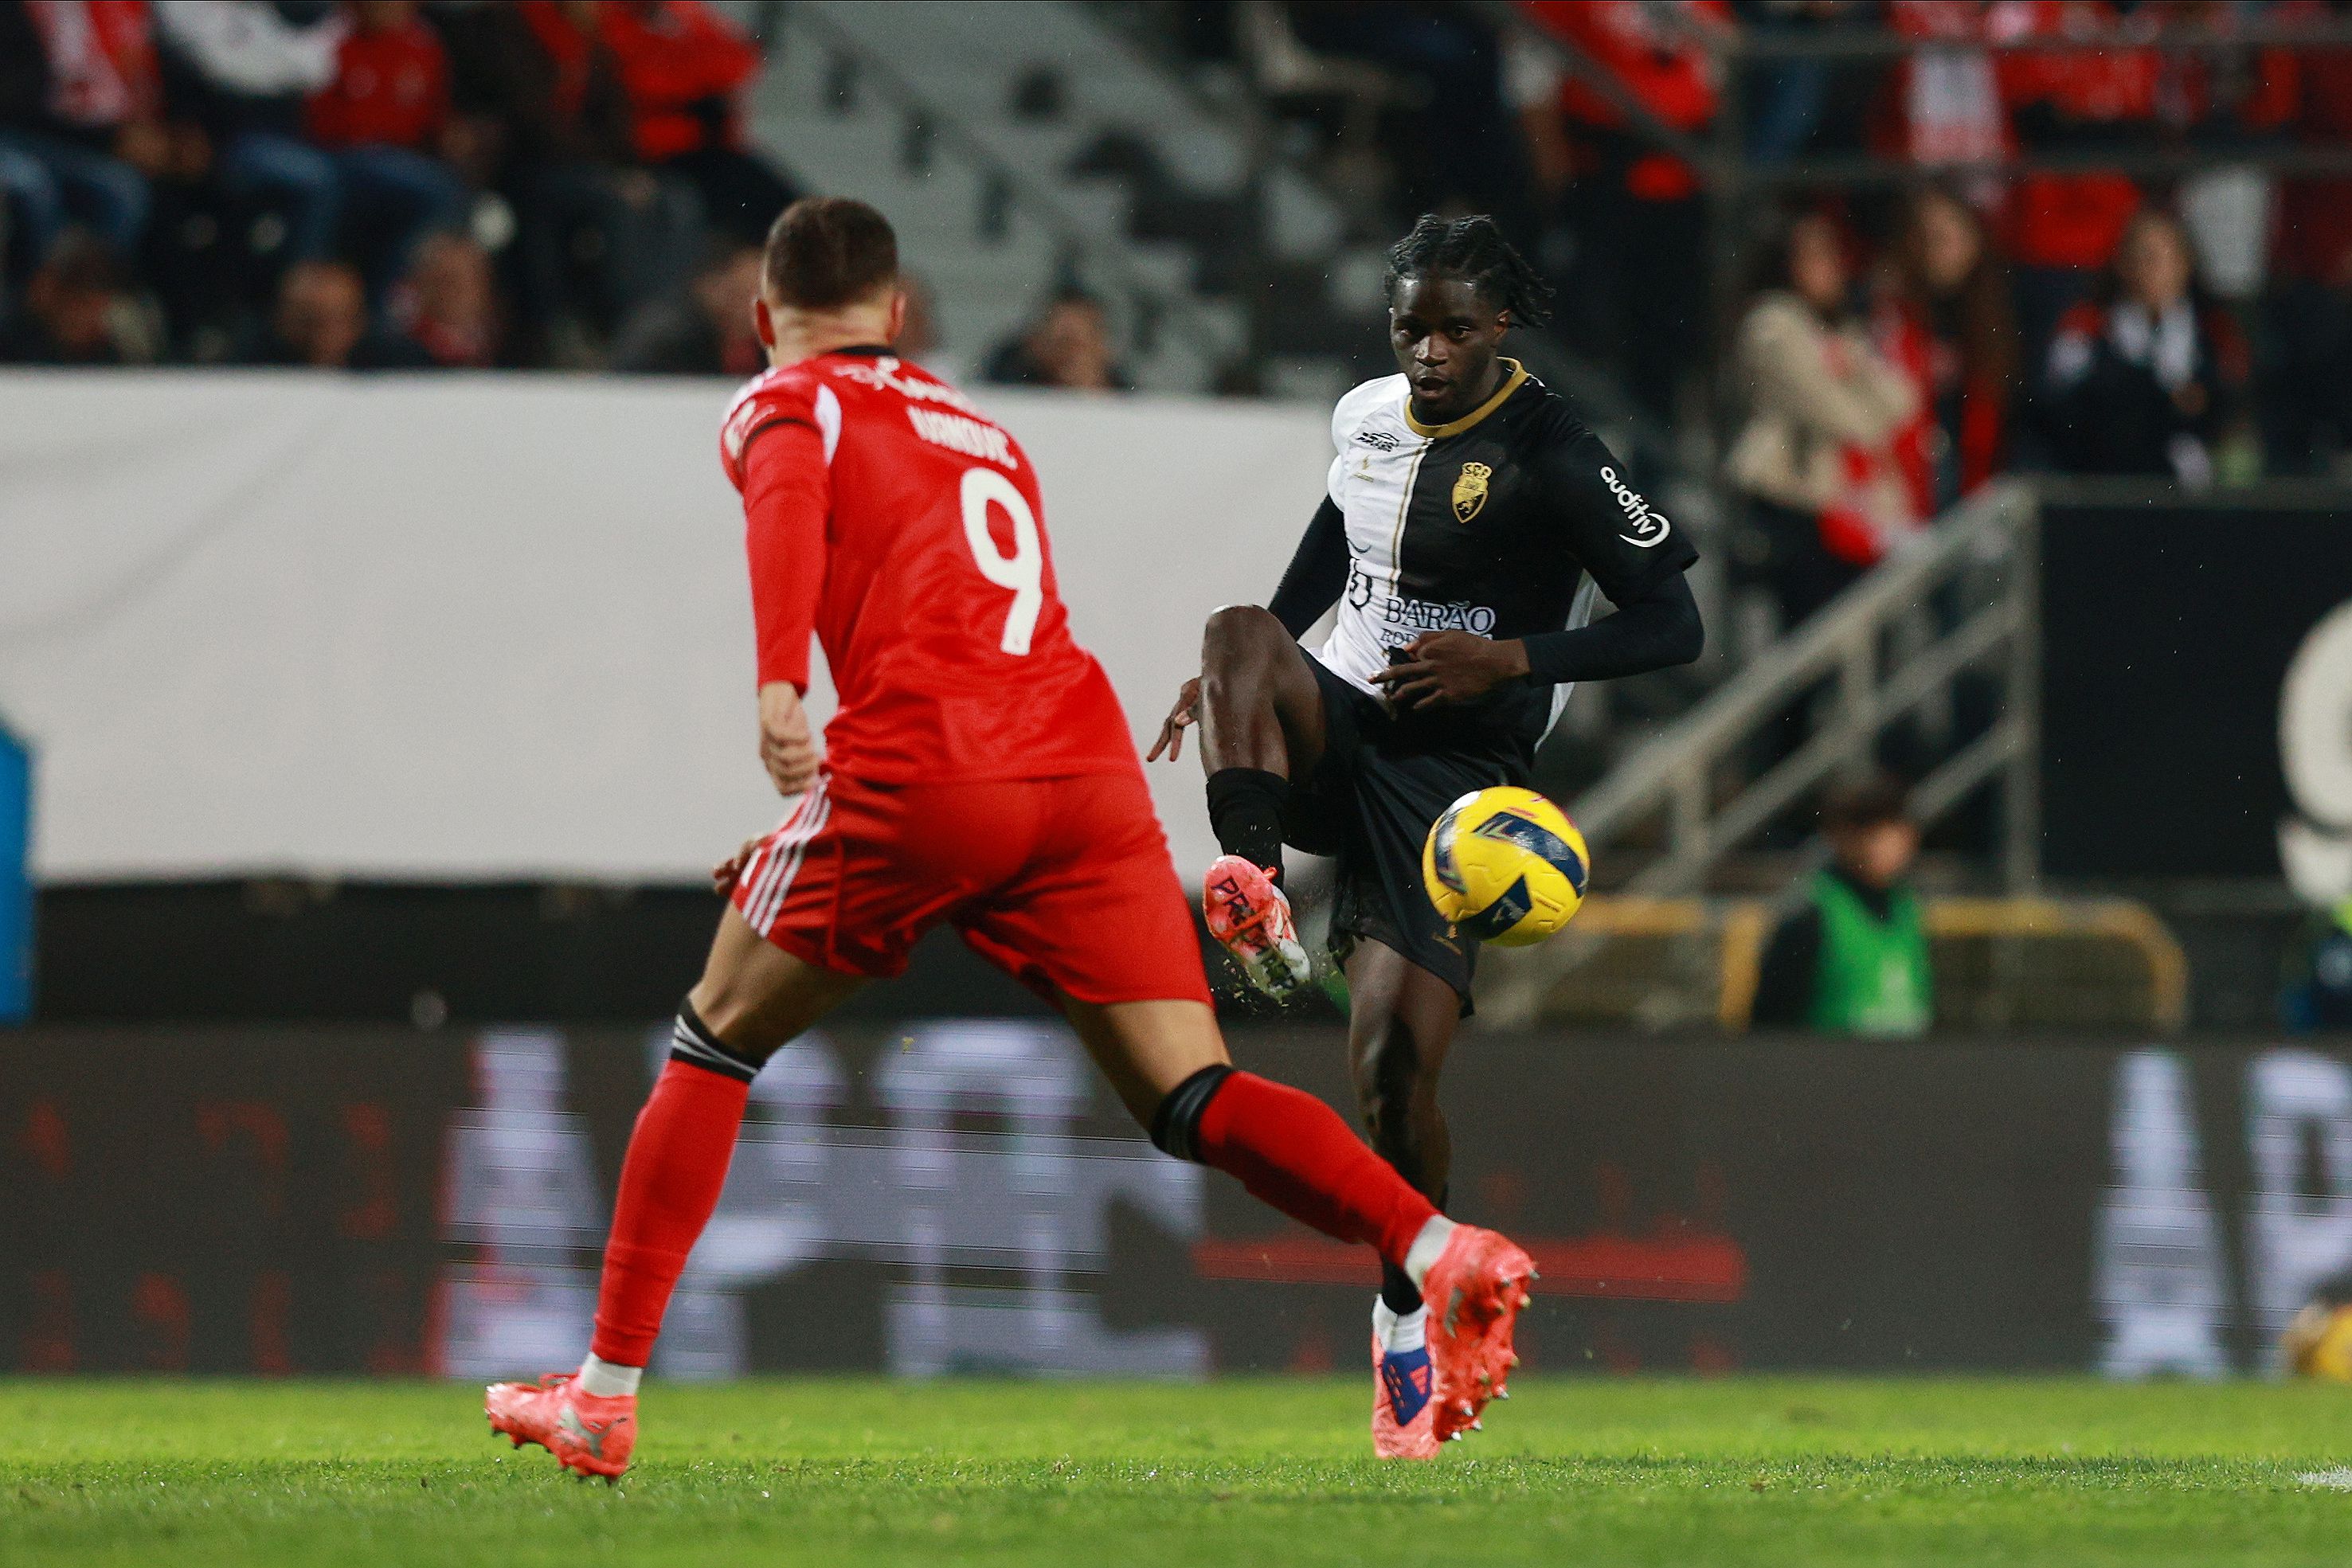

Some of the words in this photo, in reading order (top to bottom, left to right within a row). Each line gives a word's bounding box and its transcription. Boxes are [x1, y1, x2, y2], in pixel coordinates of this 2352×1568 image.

[1599, 466, 1657, 534] auditiv
[960, 467, 1043, 656] 9
[1384, 598, 1494, 634] BARÃO
